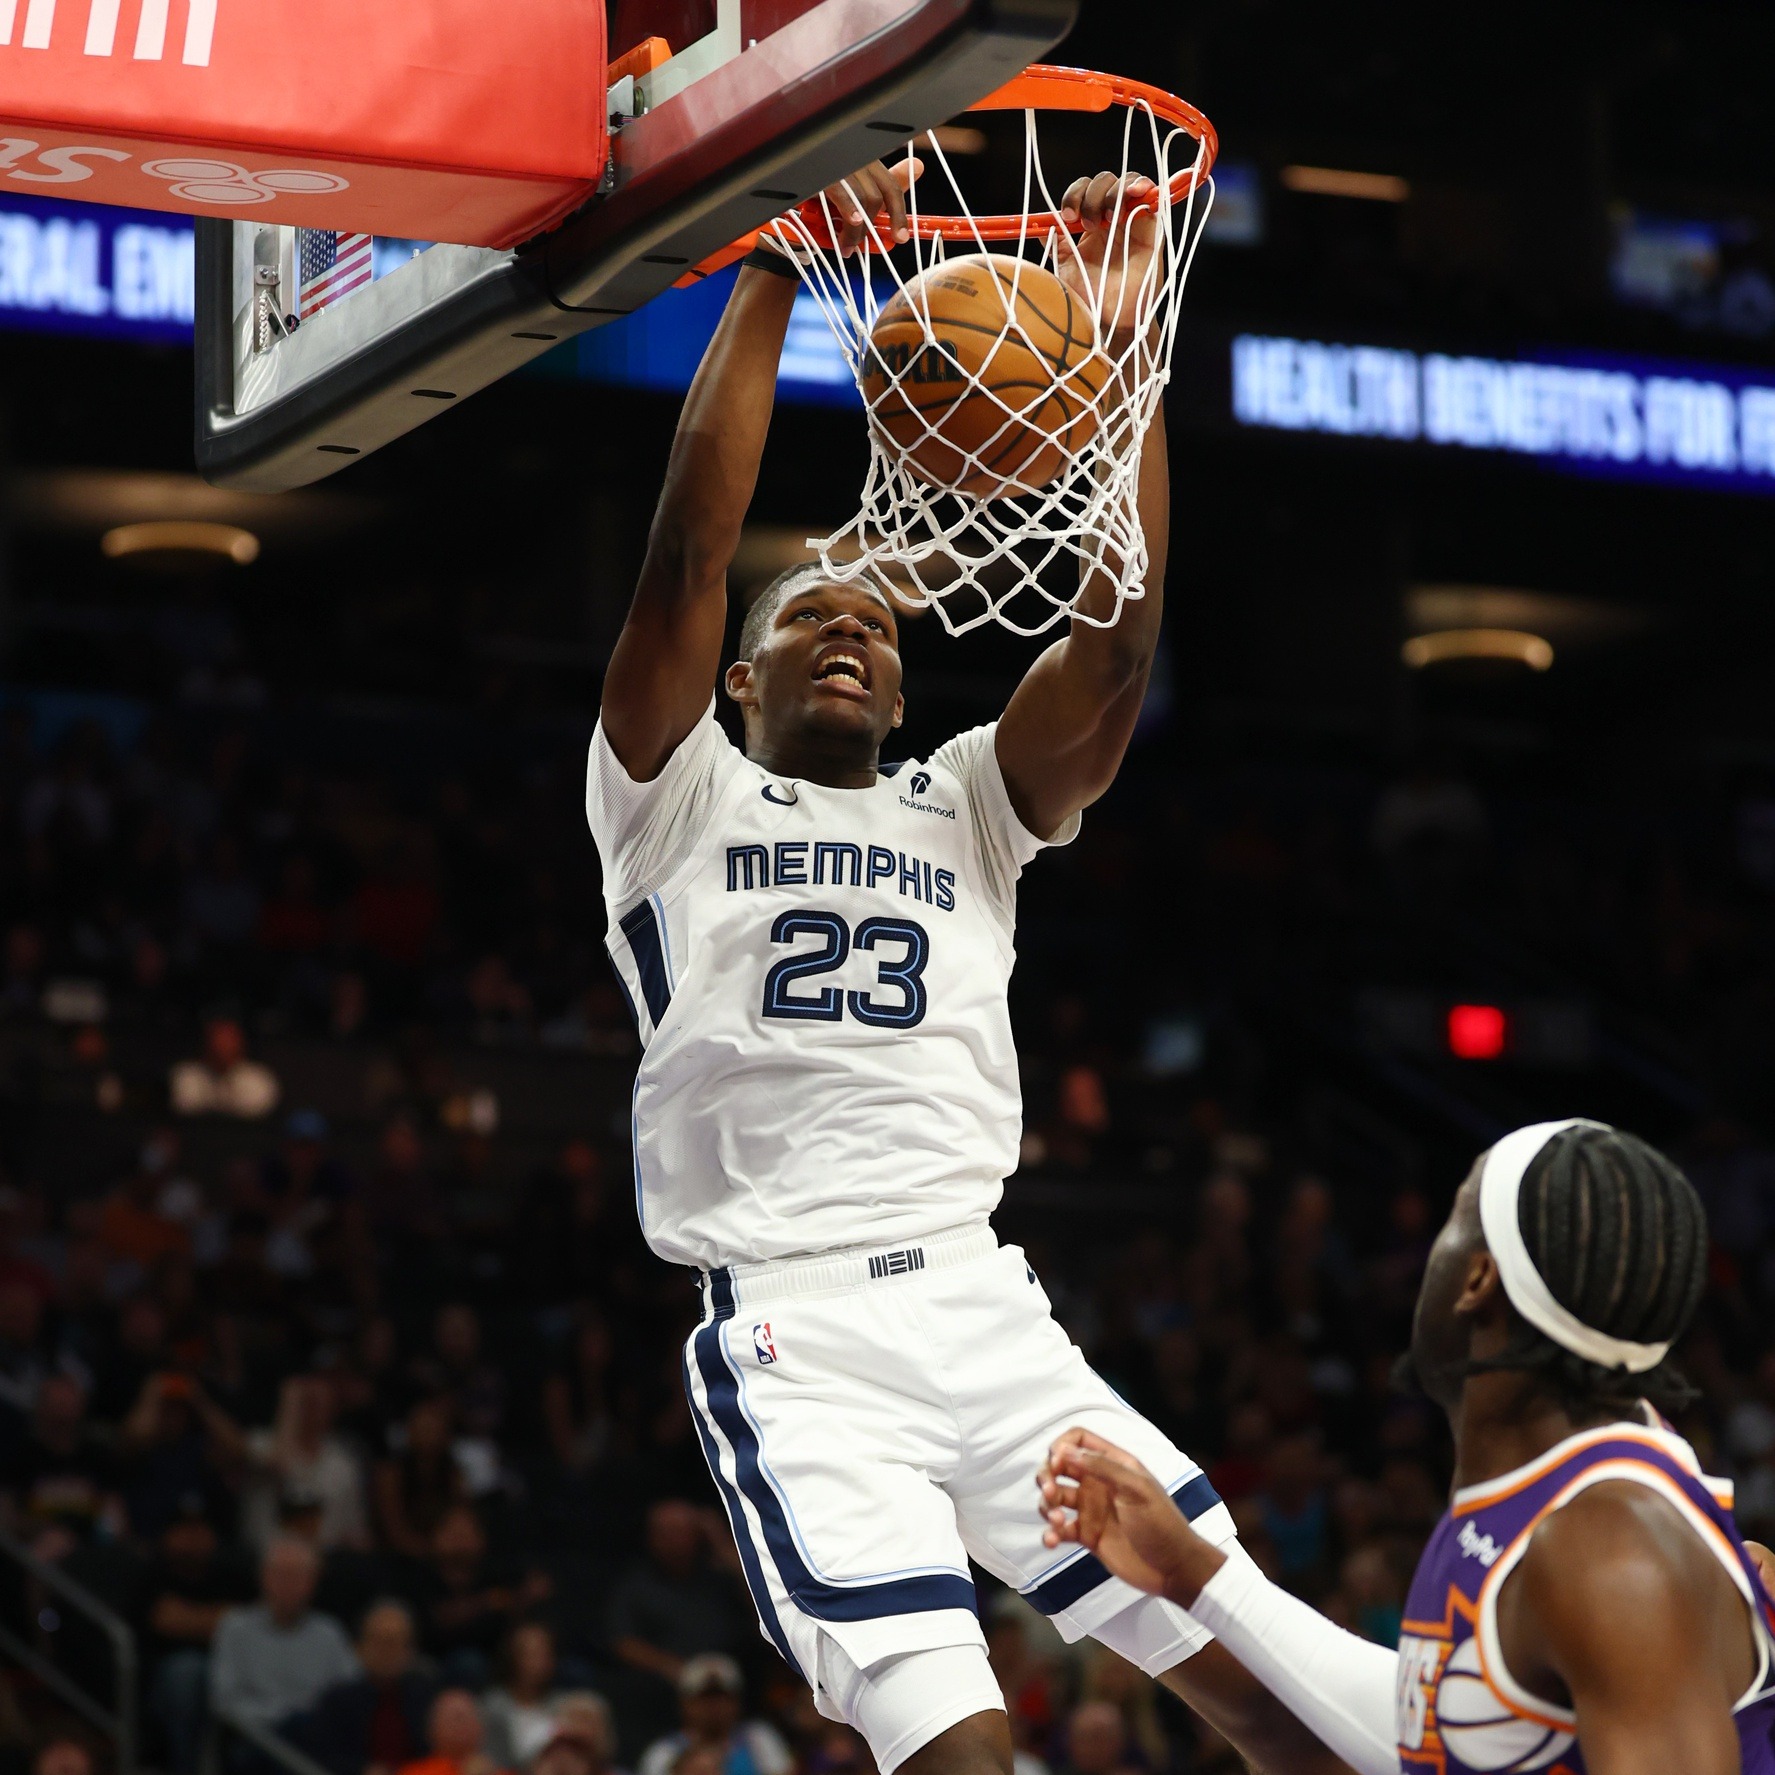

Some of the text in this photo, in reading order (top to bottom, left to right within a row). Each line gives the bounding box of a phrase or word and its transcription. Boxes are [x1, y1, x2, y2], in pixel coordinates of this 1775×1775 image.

[0, 213, 110, 318] RAL
[1232, 335, 1420, 438] HEALTH
[1423, 354, 1643, 461] BENEFITS
[1645, 376, 1737, 471] FOR
[899, 795, 956, 820] Robinhood
[726, 841, 955, 912] MEMPHIS
[762, 909, 930, 1030] 23
